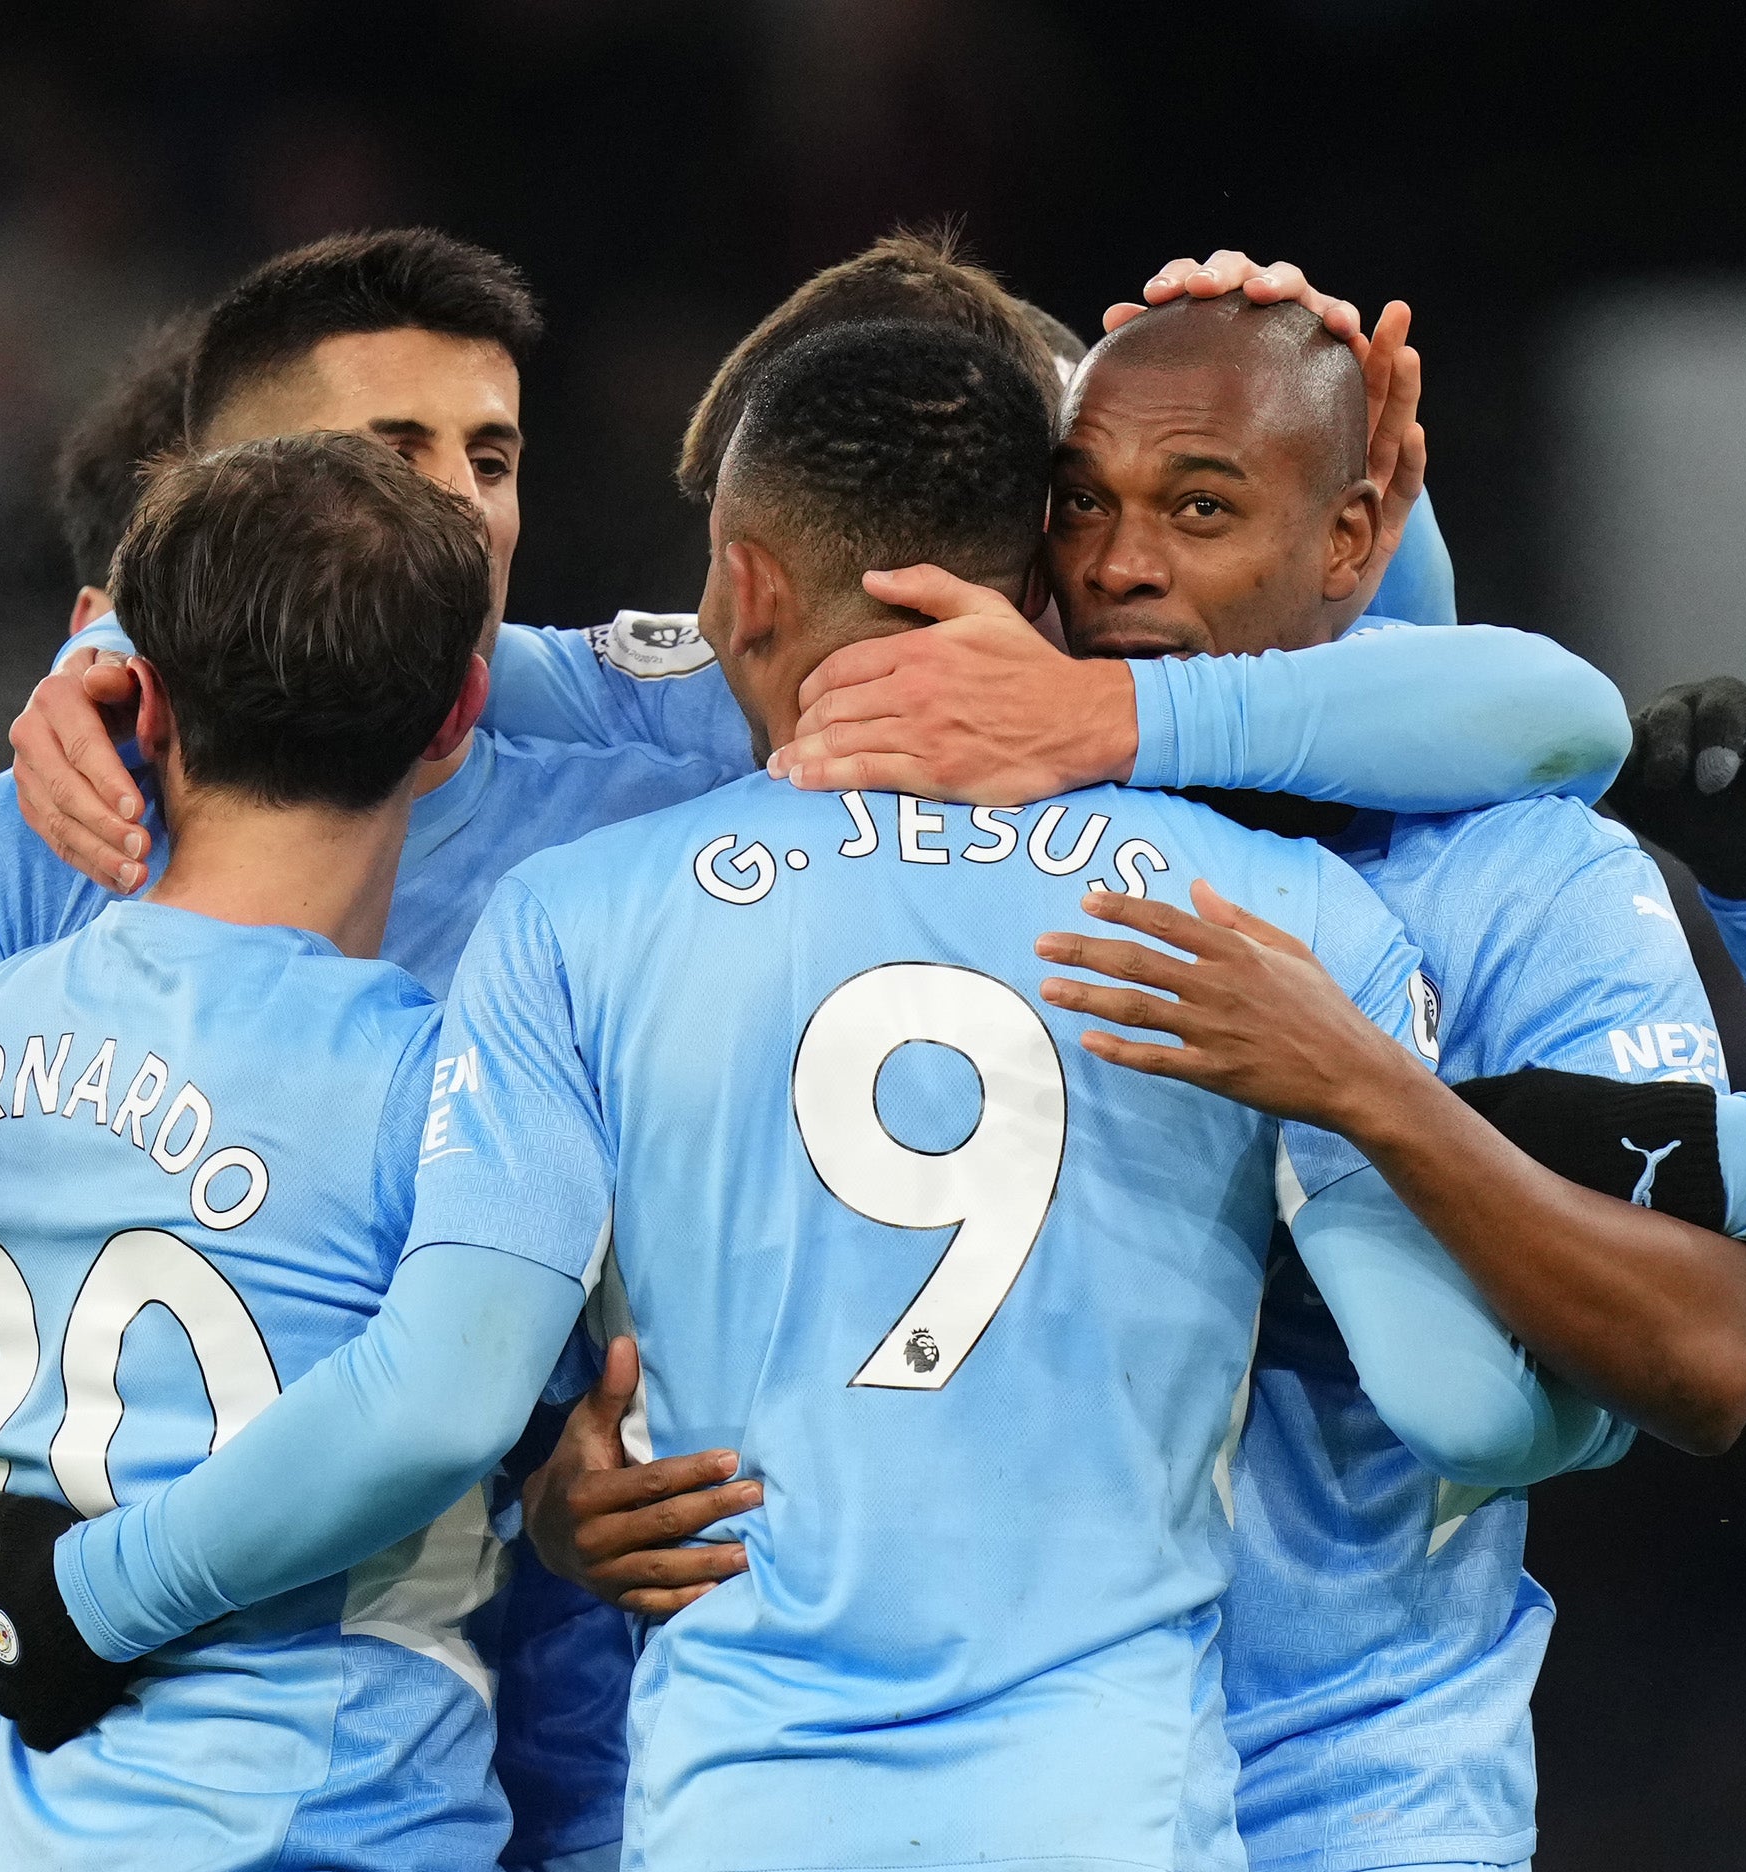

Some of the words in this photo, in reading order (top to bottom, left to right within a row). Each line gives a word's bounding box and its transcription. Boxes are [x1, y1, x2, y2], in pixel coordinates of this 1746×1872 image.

[693, 834, 810, 905] G.
[838, 790, 1171, 900] JESUS
[793, 962, 1067, 1391] 9
